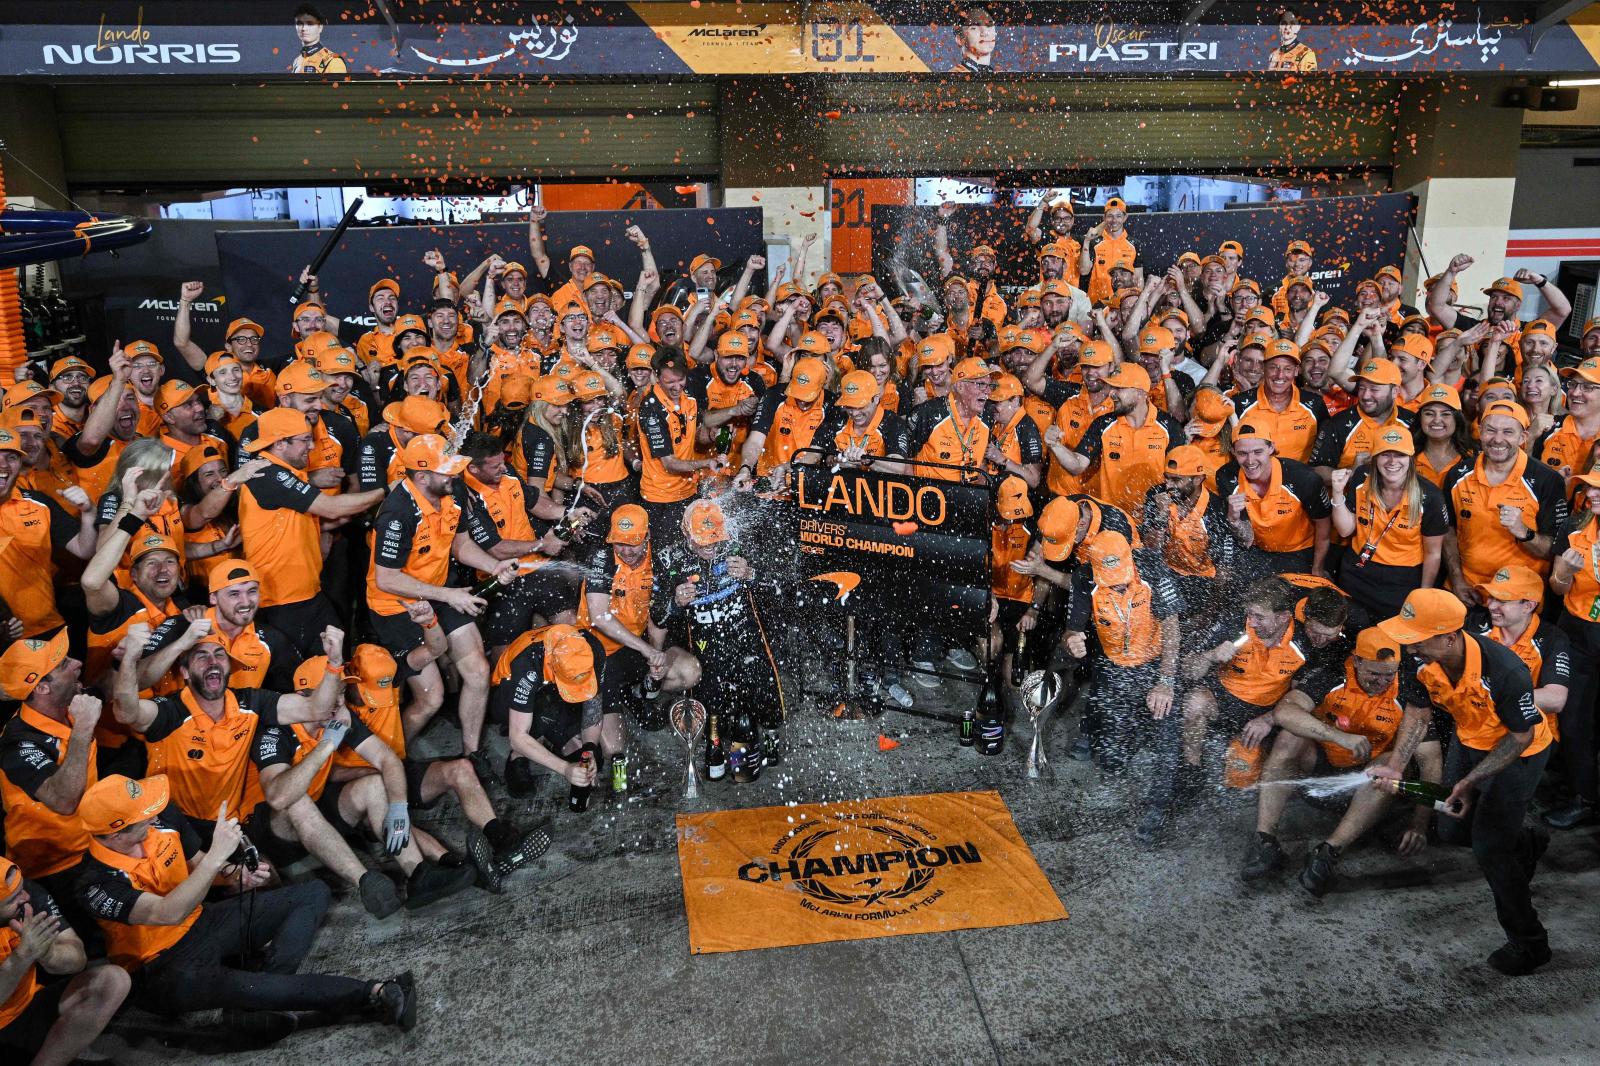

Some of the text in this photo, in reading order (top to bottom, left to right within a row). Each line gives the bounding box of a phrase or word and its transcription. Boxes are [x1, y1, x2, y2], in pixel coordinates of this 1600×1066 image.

[97, 6, 151, 51] Lando
[687, 28, 759, 36] McLaren
[1095, 15, 1151, 48] Oscar
[812, 17, 875, 62] 81
[43, 44, 241, 64] NORRIS
[1050, 43, 1218, 62] PIASTRI
[138, 299, 217, 312] McLren
[799, 472, 946, 526] LANDO
[1014, 508, 1025, 516] 81
[800, 531, 915, 558] WORLD CHAMPION
[801, 545, 824, 555] 2025
[516, 686, 530, 696] okta
[260, 742, 277, 751] okta
[738, 841, 983, 884] CHAMPION
[854, 909, 912, 921] FORMULA
[919, 889, 945, 907] TEAM
